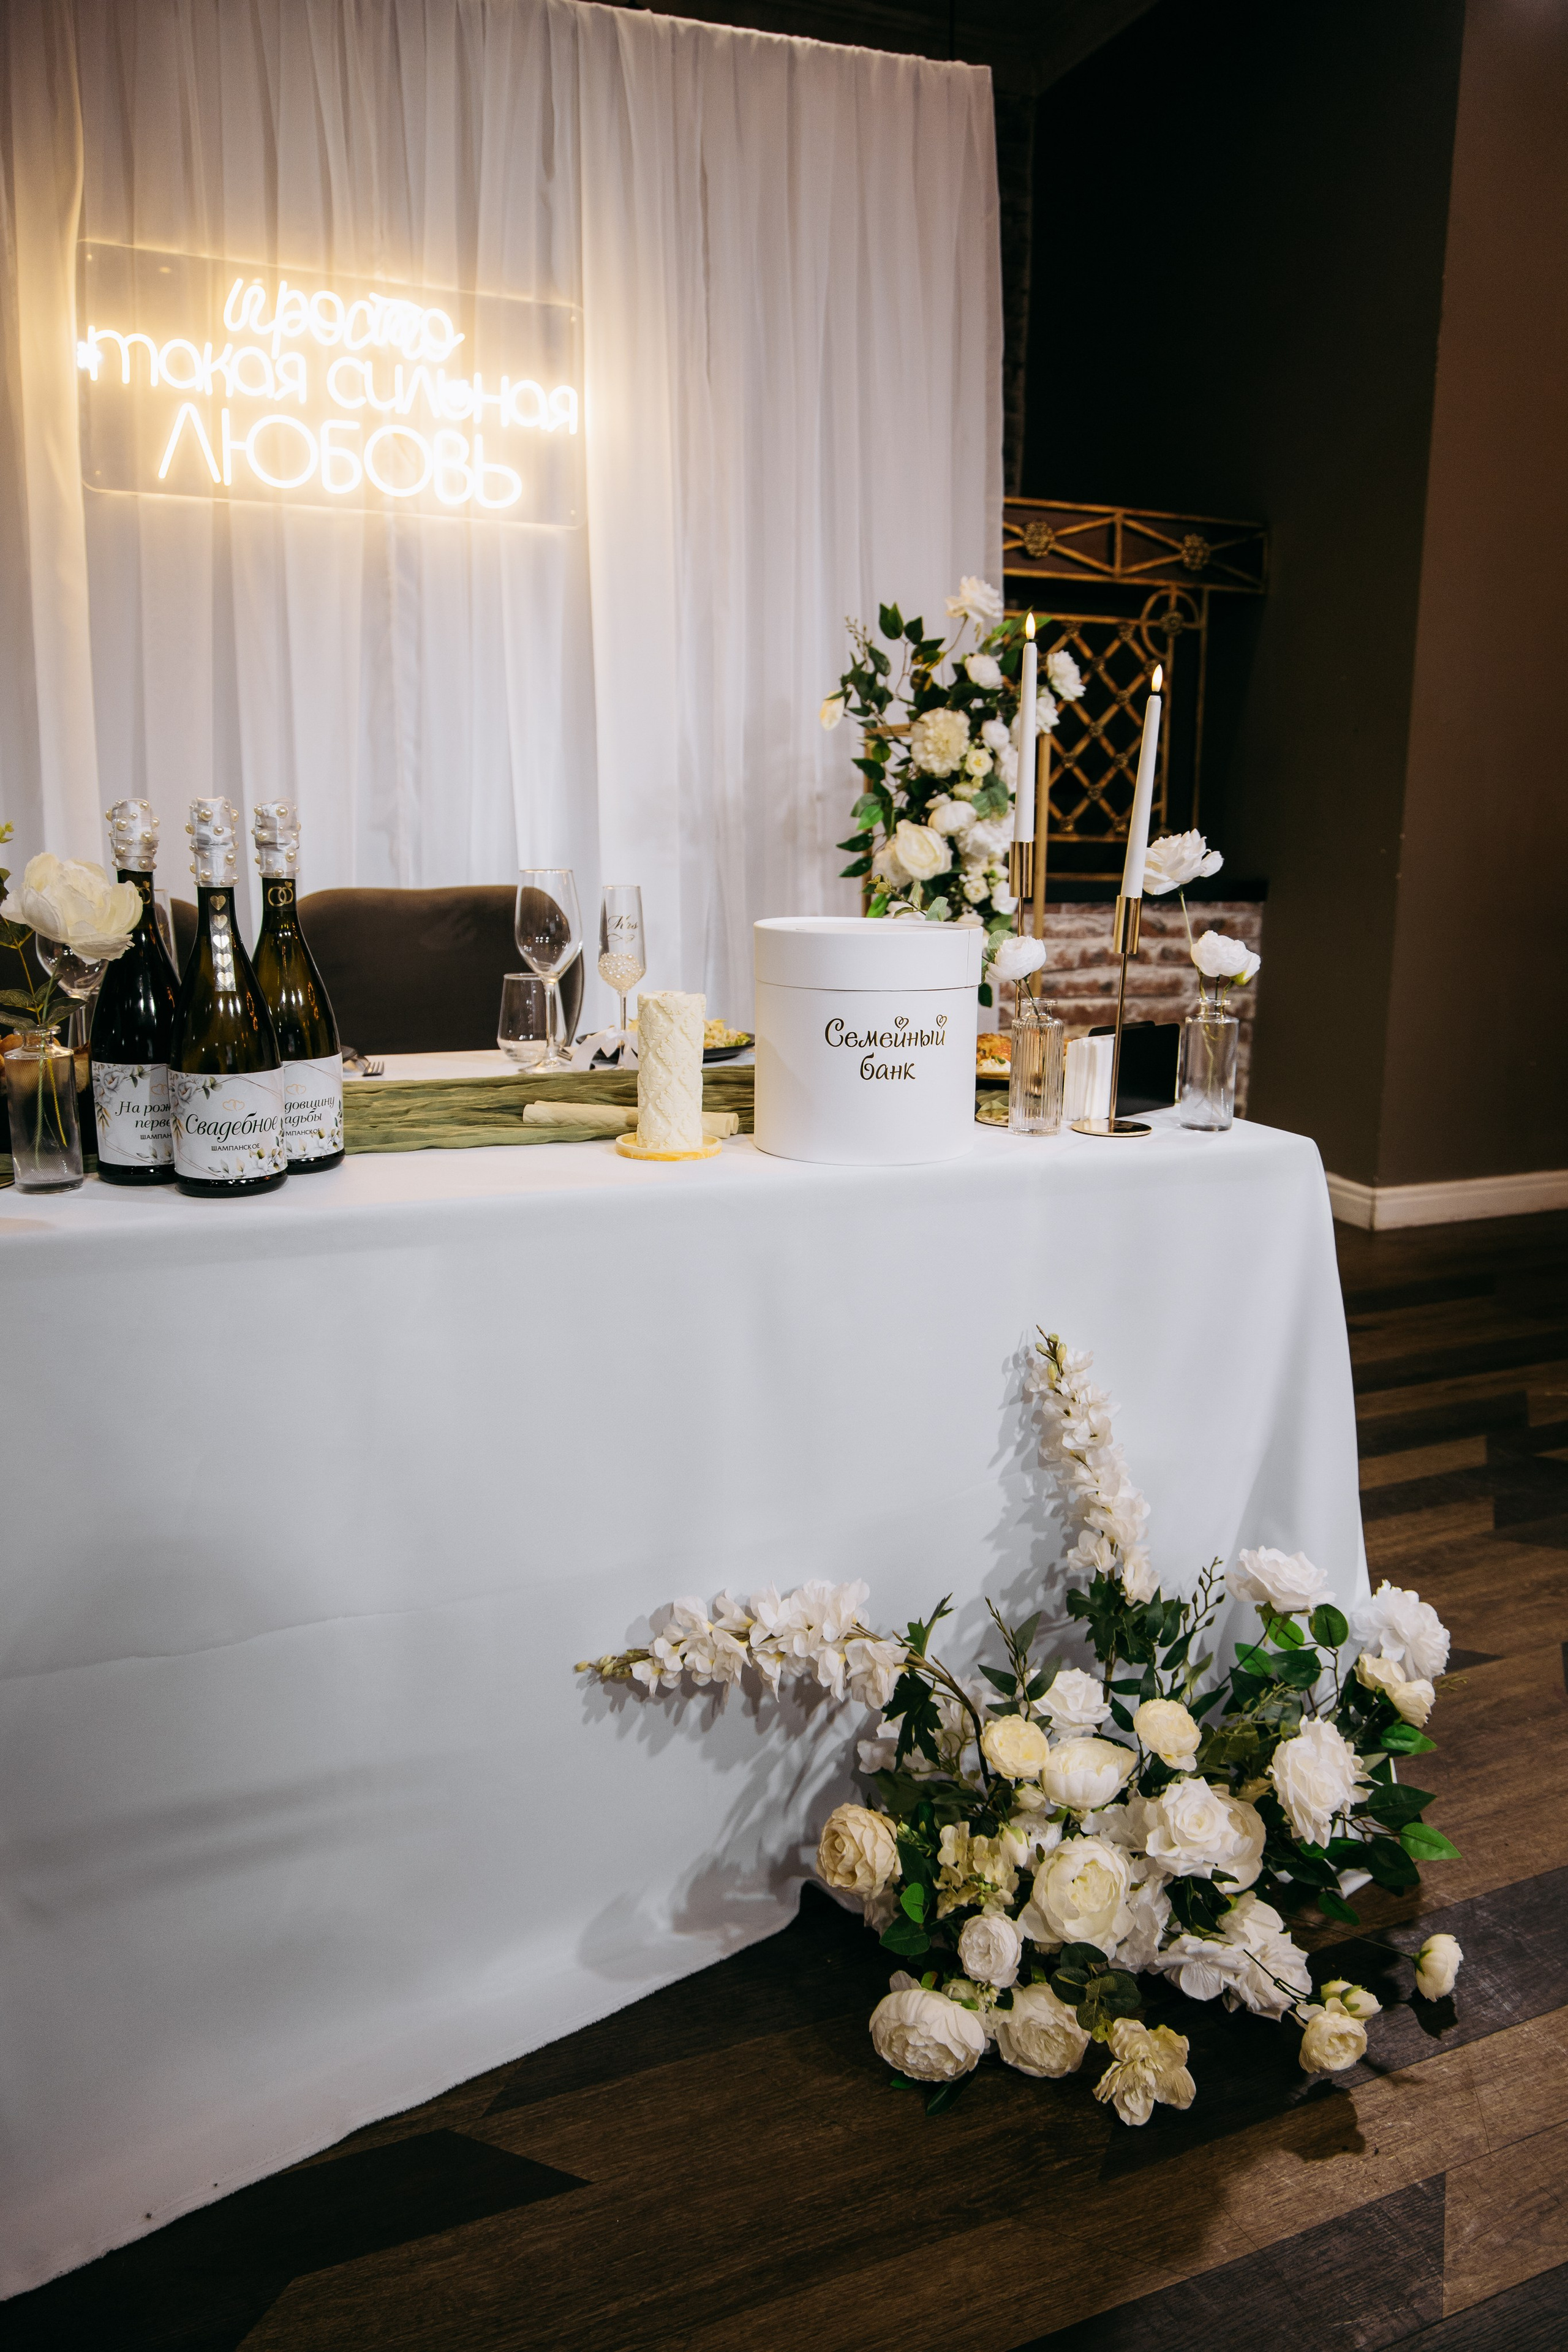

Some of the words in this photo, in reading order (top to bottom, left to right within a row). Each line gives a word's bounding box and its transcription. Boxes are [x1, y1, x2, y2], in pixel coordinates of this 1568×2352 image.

[85, 324, 308, 404] такая
[325, 356, 579, 435] сильная
[157, 402, 522, 509] ЛЮБОВЬ
[607, 914, 638, 929] Mrs
[824, 1014, 948, 1048] Семейный
[860, 1052, 916, 1080] банк
[115, 1101, 141, 1117] На
[185, 1110, 279, 1144] Свадебное
[211, 1143, 260, 1152] ШАМПАНСКОЕ
